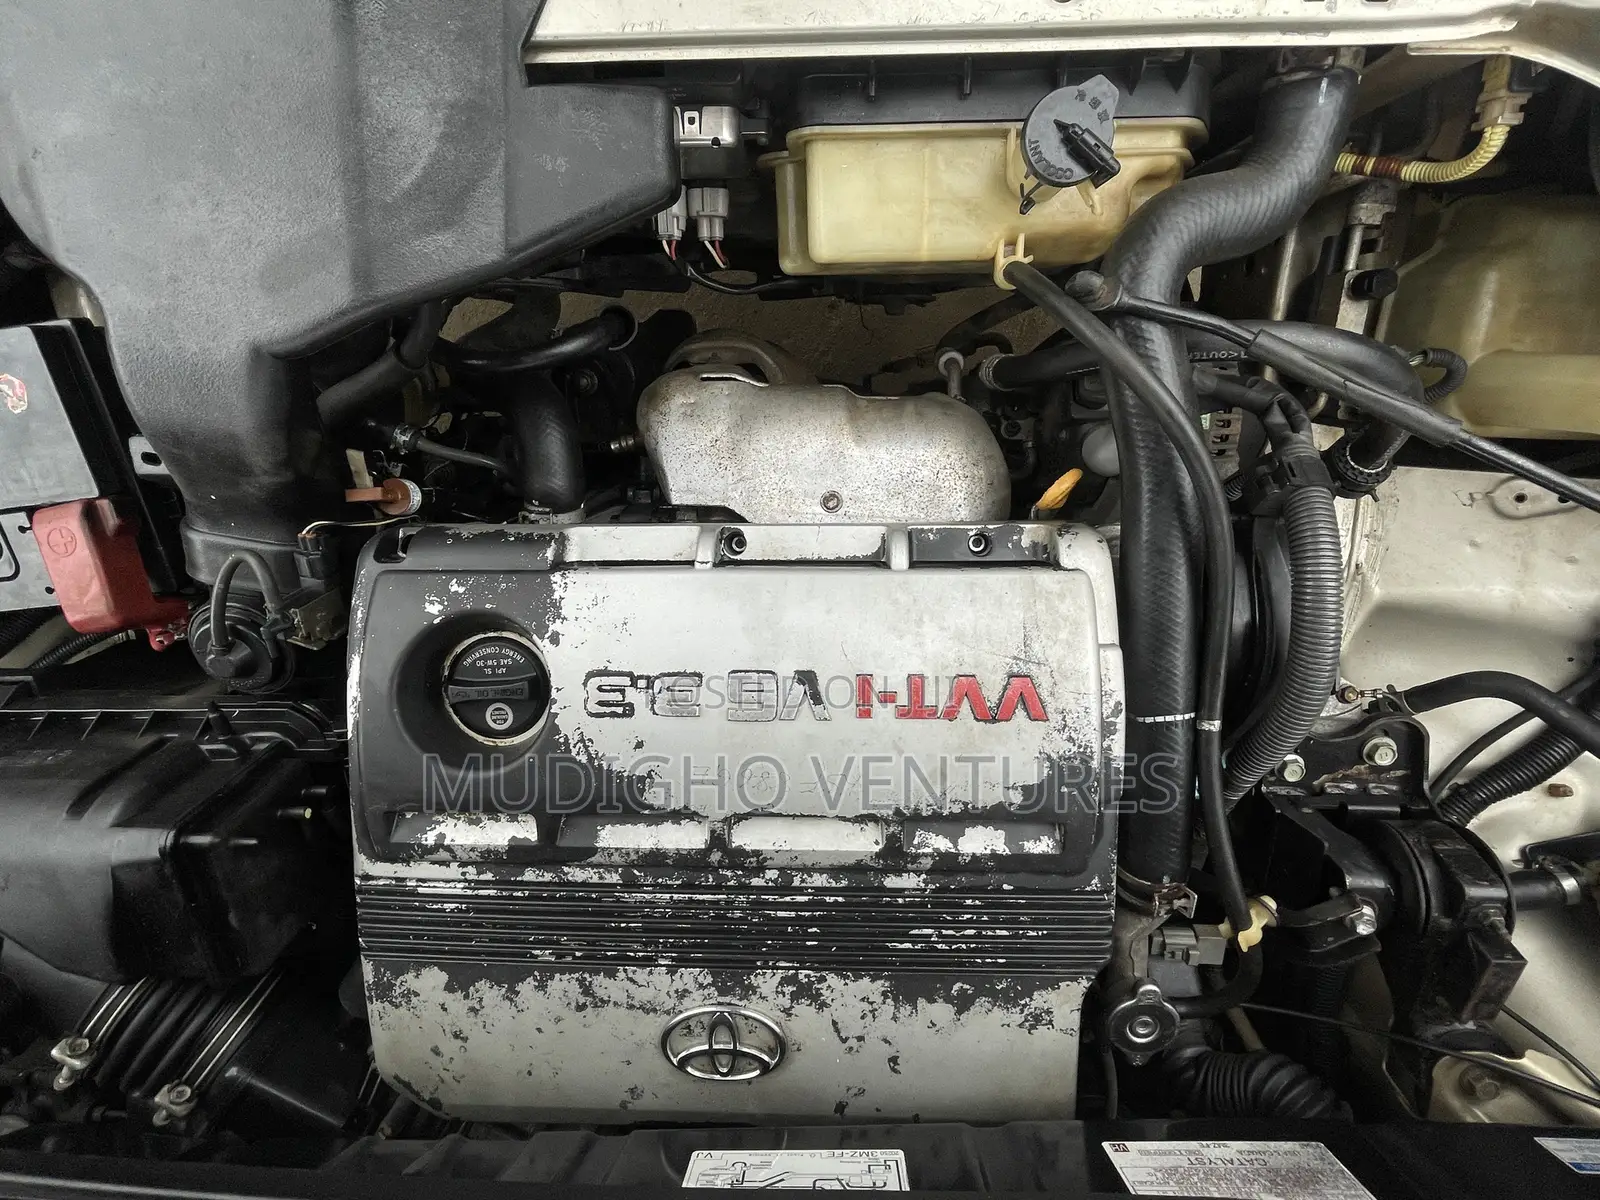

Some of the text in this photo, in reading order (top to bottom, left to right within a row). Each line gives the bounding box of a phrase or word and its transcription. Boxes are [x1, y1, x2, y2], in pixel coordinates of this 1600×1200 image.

[1028, 138, 1074, 180] COOLANT
[462, 646, 526, 667] ENERGY CONSERVING
[475, 658, 513, 667] SAE 5W-30
[483, 667, 507, 675] API SL
[474, 687, 525, 698] ENGINE OIL
[583, 669, 703, 719] 3.3
[727, 670, 831, 723] V6
[1110, 1143, 1128, 1152] VH
[696, 1151, 713, 1159] VJ
[826, 1150, 878, 1158] 3MZ-FE
[1186, 1156, 1268, 1167] CATALYST
